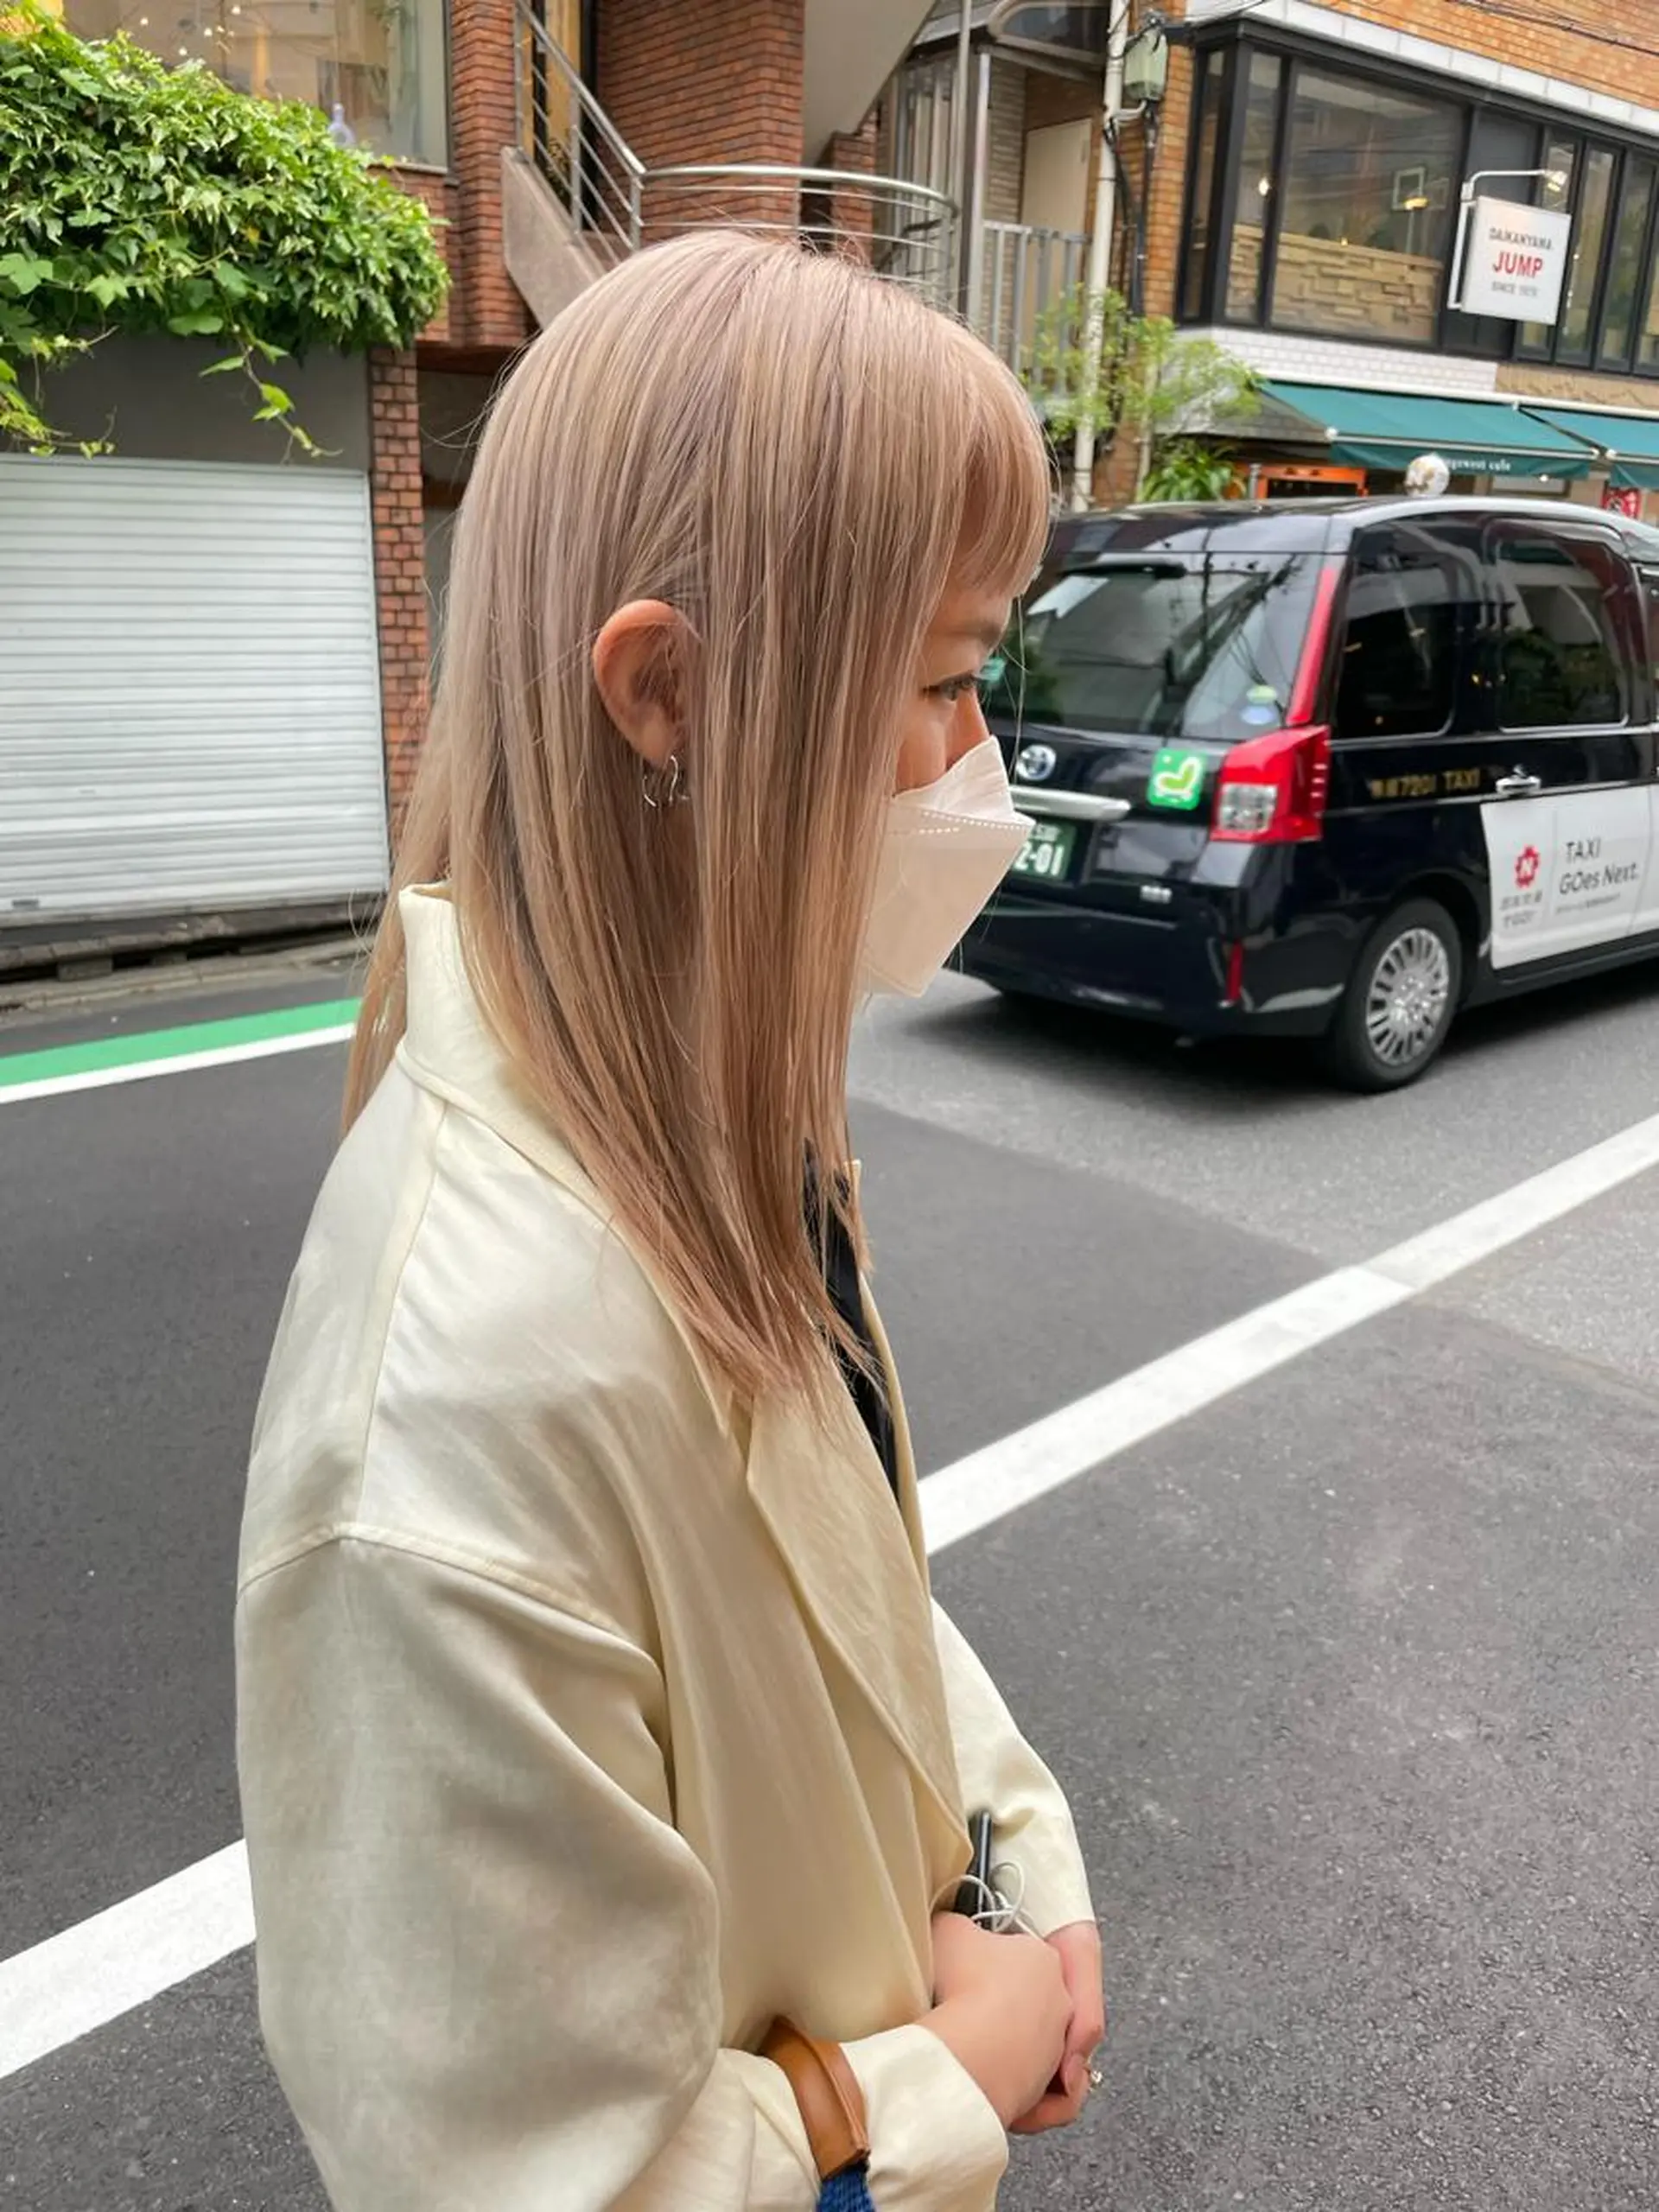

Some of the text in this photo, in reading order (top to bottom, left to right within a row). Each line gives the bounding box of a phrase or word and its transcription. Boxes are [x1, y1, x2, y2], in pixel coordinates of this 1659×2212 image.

[1492, 251, 1543, 278] JUMP
[1014, 841, 1064, 876] 2-01
[1566, 837, 1601, 862] TAXI
[1559, 870, 1599, 895] GOes
